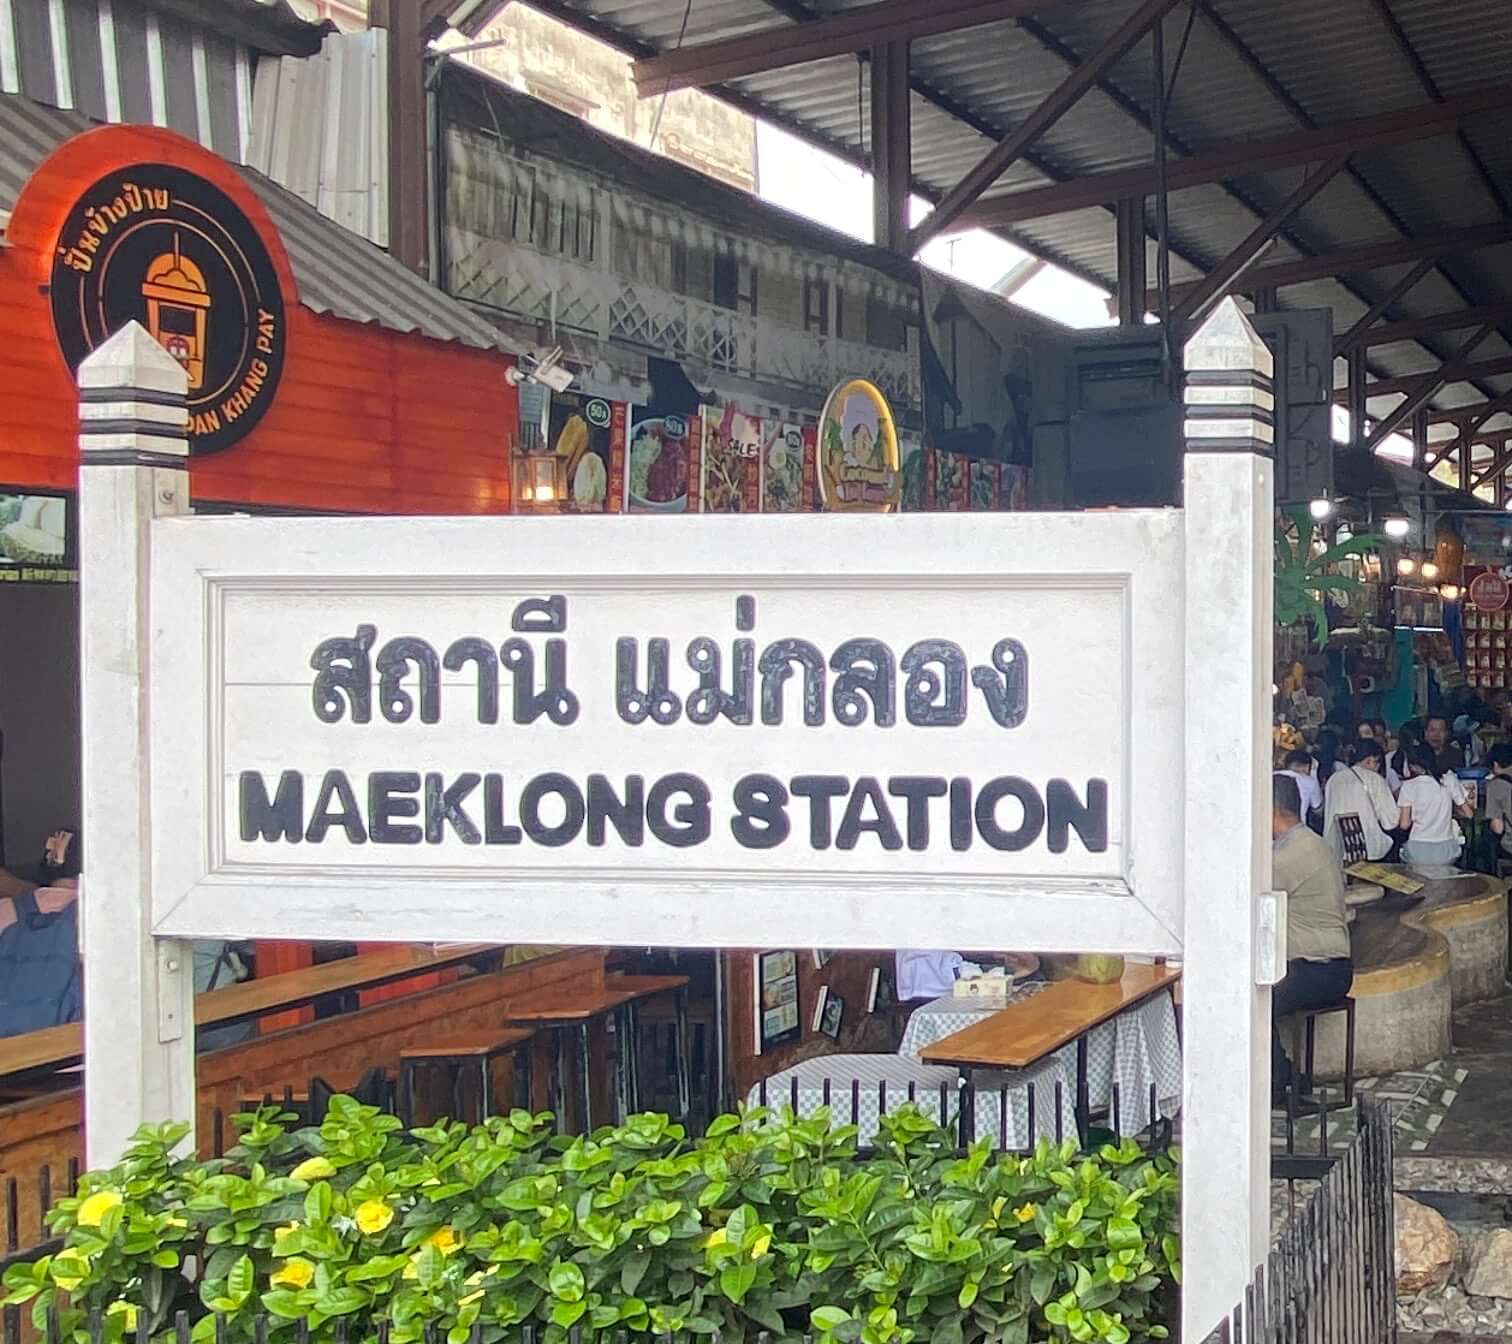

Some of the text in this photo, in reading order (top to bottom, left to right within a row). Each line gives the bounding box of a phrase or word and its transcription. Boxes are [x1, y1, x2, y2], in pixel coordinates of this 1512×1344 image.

[225, 358, 269, 423] KHANG
[256, 308, 275, 354] PAY
[311, 594, 1030, 729] สถานี แม่กลอง
[239, 768, 1109, 854] MAEKLONG STATION
